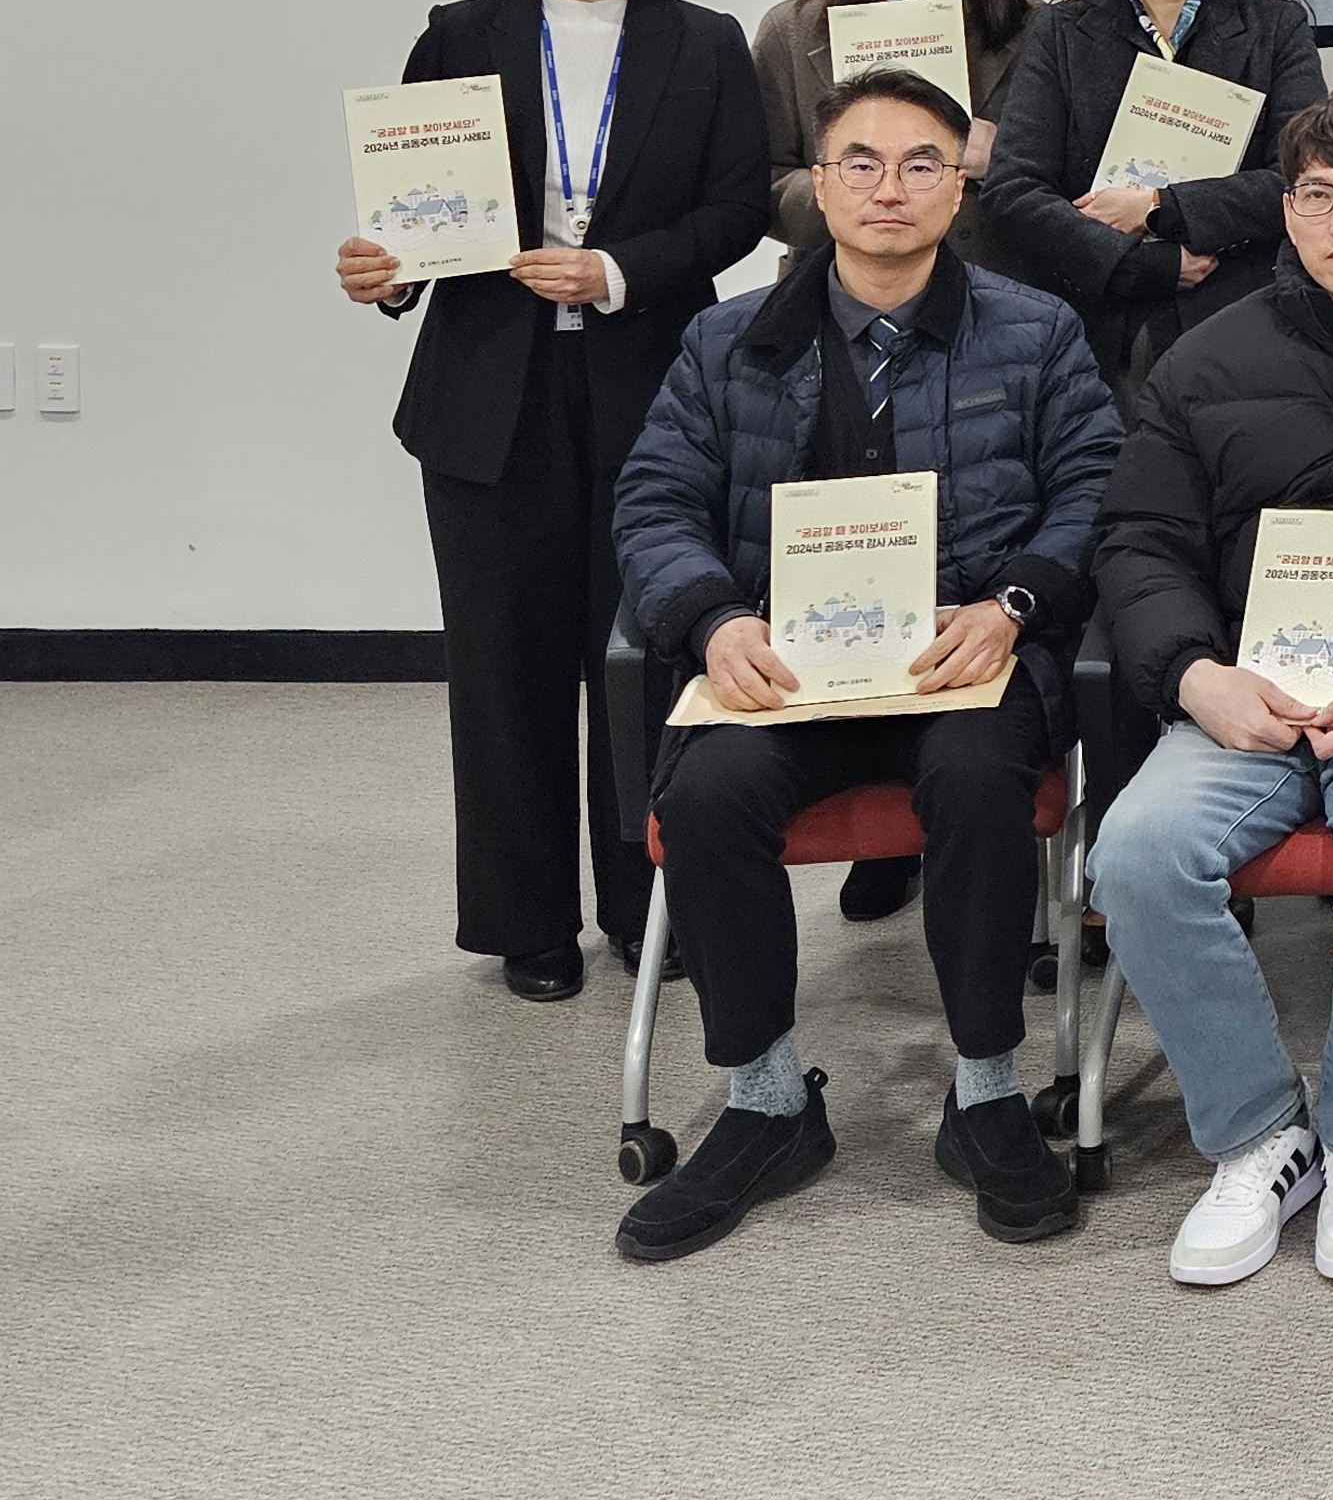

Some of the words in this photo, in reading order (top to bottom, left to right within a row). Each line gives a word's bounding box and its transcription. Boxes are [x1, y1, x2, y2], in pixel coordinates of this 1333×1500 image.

[363, 140, 398, 153] 2024년
[400, 136, 439, 149] 공동주택
[786, 542, 822, 554] 2024년
[824, 539, 864, 552] 공동주택
[1264, 568, 1298, 579] 2024년
